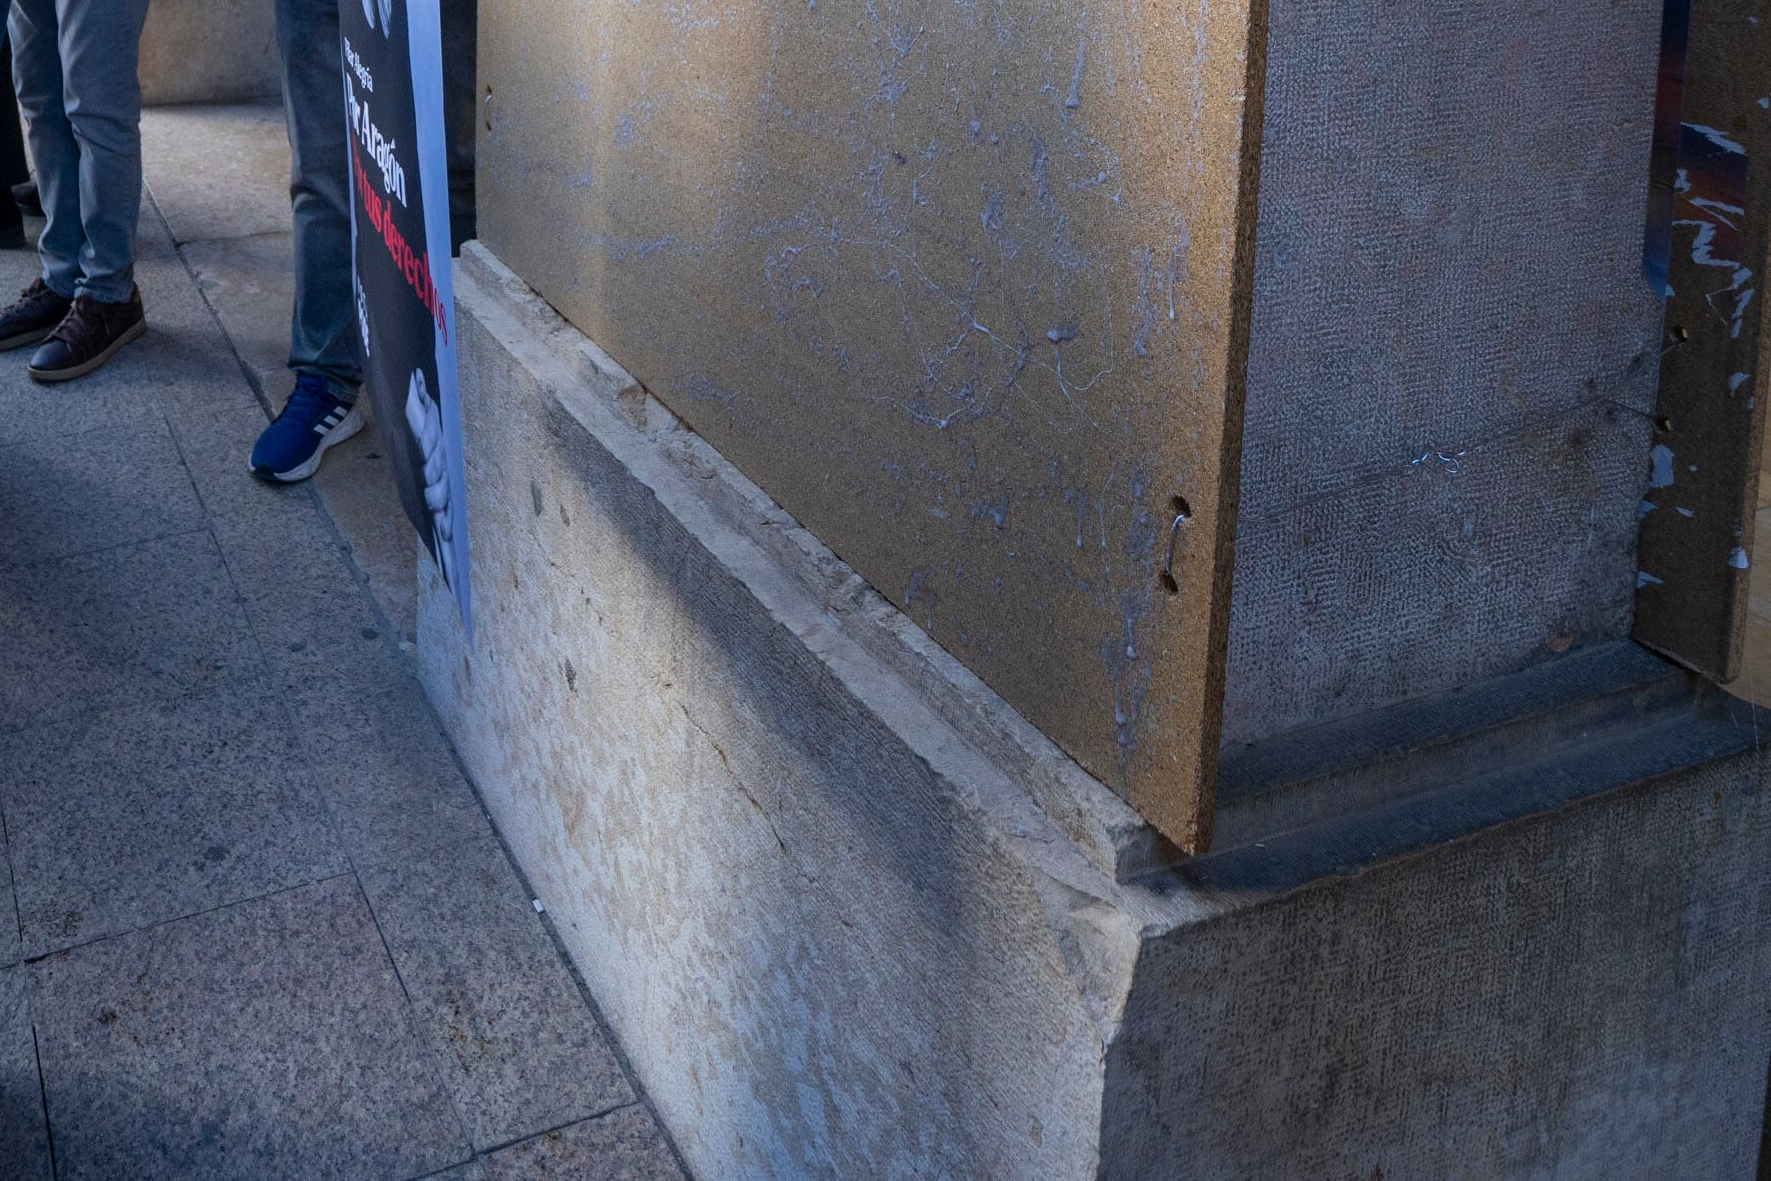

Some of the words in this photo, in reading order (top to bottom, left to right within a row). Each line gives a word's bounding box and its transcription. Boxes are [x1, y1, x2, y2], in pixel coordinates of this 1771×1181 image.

[346, 71, 360, 136] Por
[361, 100, 407, 208] Aragón
[363, 170, 382, 234] tus
[383, 199, 448, 347] derechos
